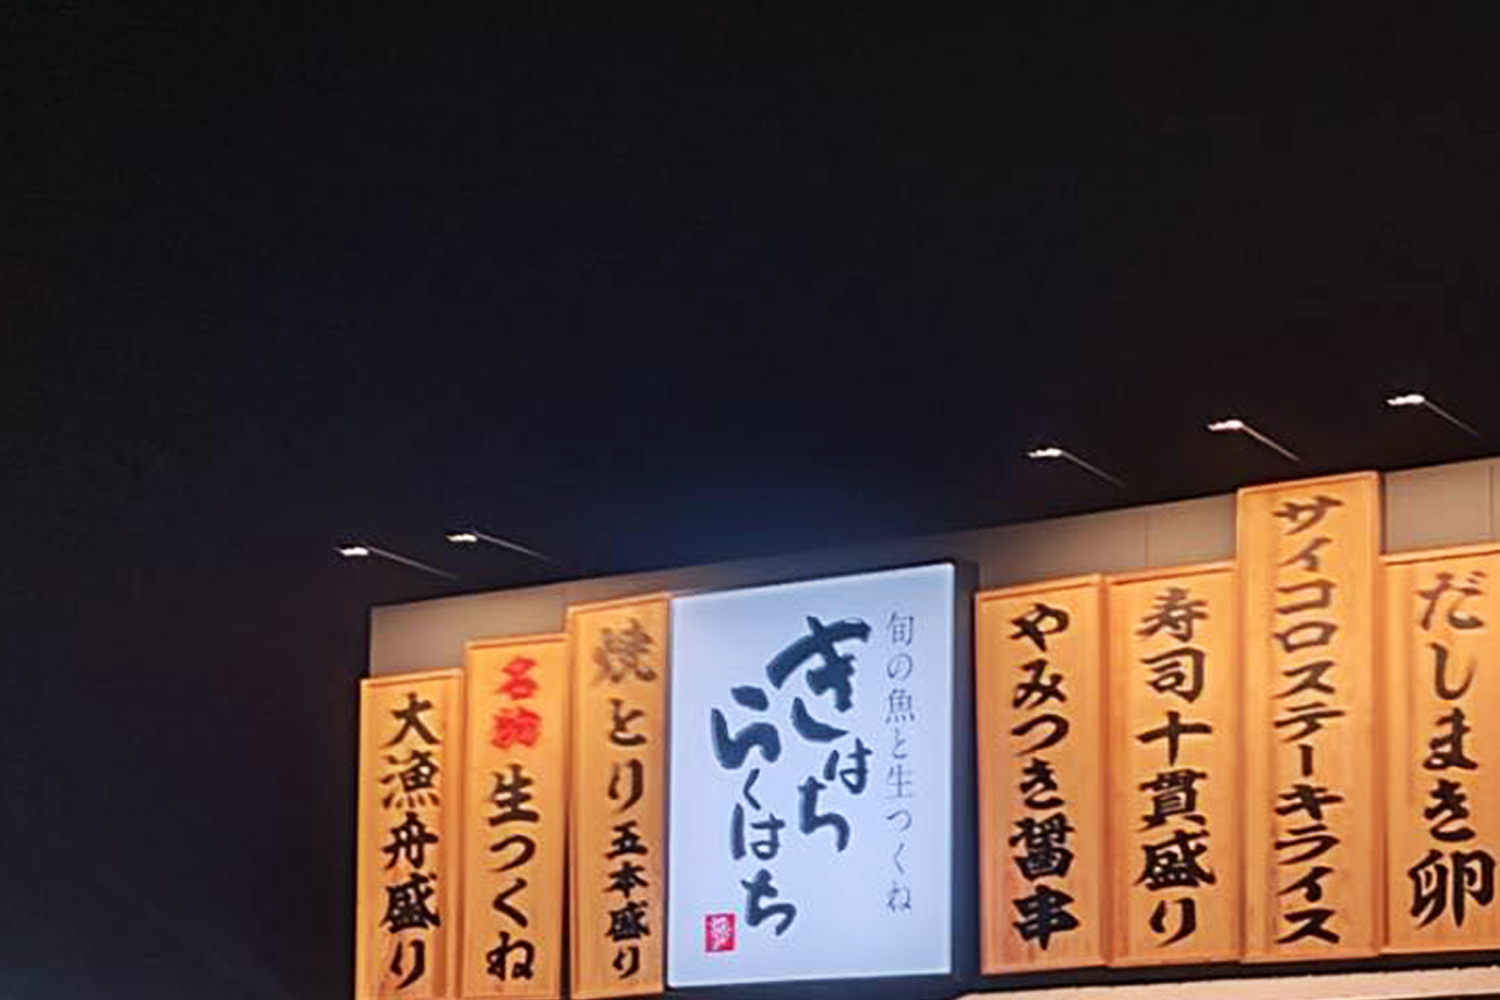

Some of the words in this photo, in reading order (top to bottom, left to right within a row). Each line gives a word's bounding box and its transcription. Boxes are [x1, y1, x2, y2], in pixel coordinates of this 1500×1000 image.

[379, 692, 442, 990] 大漁舟盛り
[485, 654, 542, 982] 名物生つくね
[596, 615, 659, 980] 焼とり五本盛り
[711, 684, 797, 938] らくはち
[886, 610, 917, 913] 旬の魚と生つくね
[1135, 585, 1217, 948] 寿司十貫盛り
[1272, 494, 1345, 946] サイコロステーキライス
[1407, 569, 1497, 930] だしまき卵
